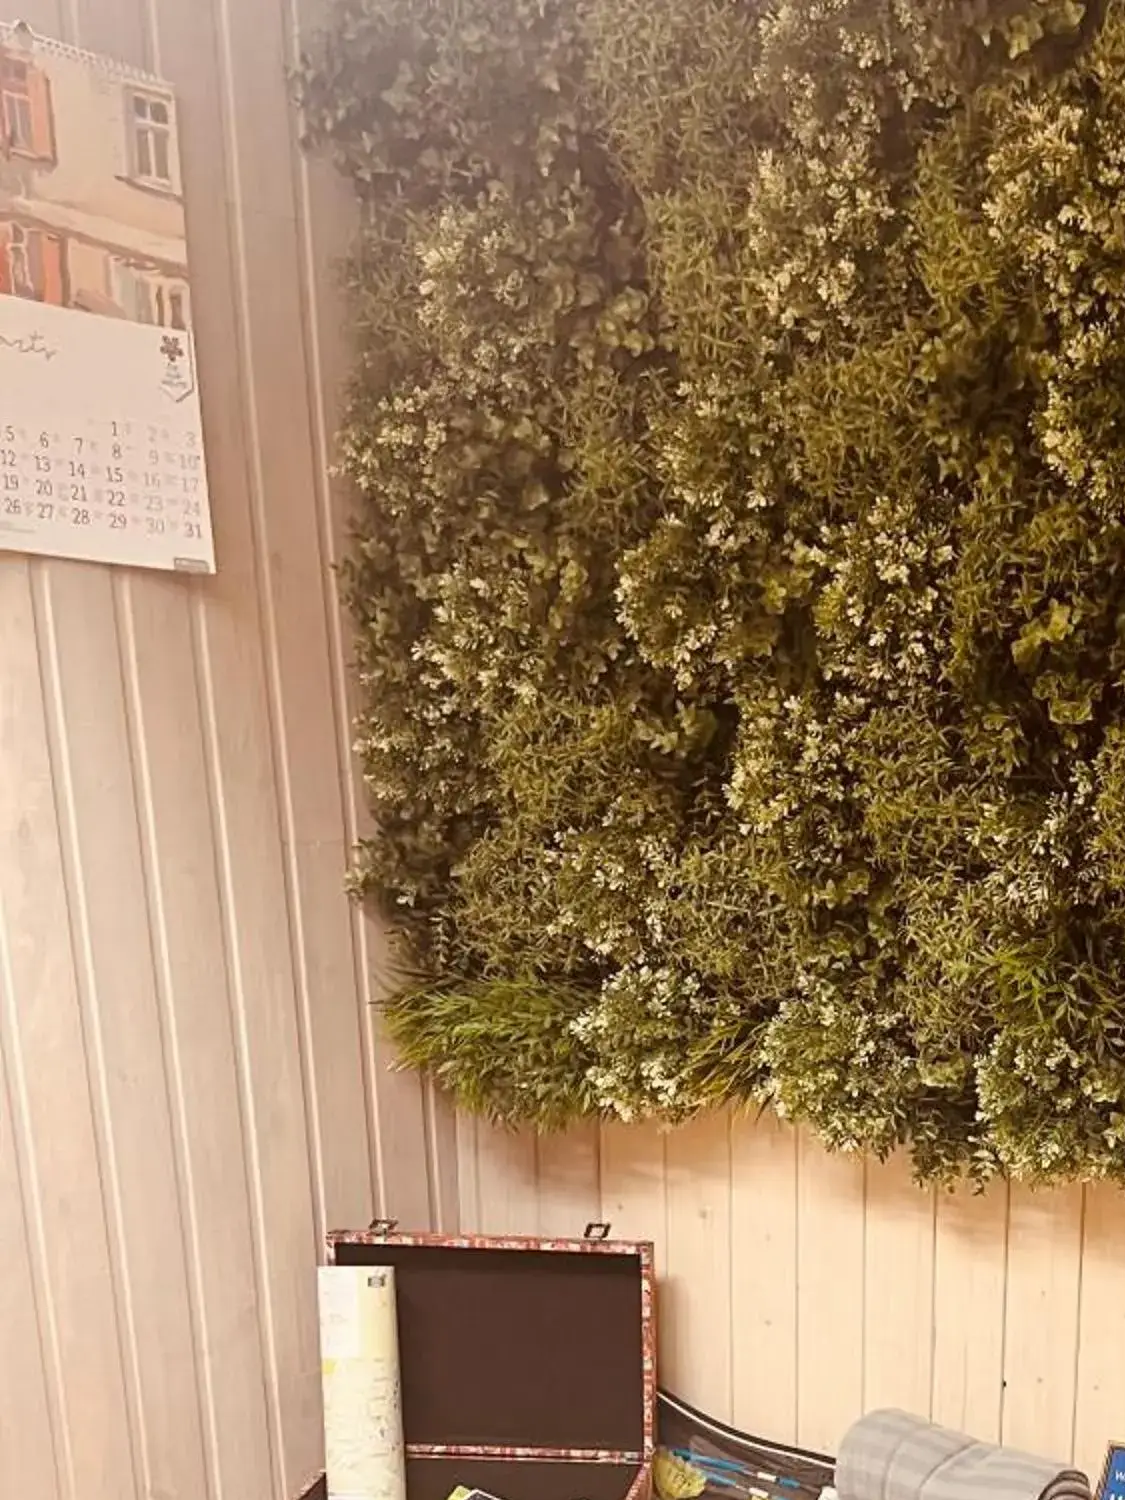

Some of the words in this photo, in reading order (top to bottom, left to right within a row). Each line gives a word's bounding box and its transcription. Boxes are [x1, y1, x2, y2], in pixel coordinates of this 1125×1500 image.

[5, 425, 16, 443] 5
[39, 431, 50, 449] 6
[73, 437, 84, 455] 7
[111, 443, 124, 460] 8
[110, 420, 119, 438] 1
[34, 454, 52, 474] 13
[68, 460, 86, 479] 14
[105, 466, 125, 484] 15
[3, 472, 20, 491] 19
[35, 478, 54, 498] 20
[70, 484, 88, 503] 21
[106, 490, 127, 507] 22
[36, 502, 54, 520] 27
[72, 507, 91, 526] 28
[108, 513, 128, 530] 29
[184, 522, 203, 540] 31
